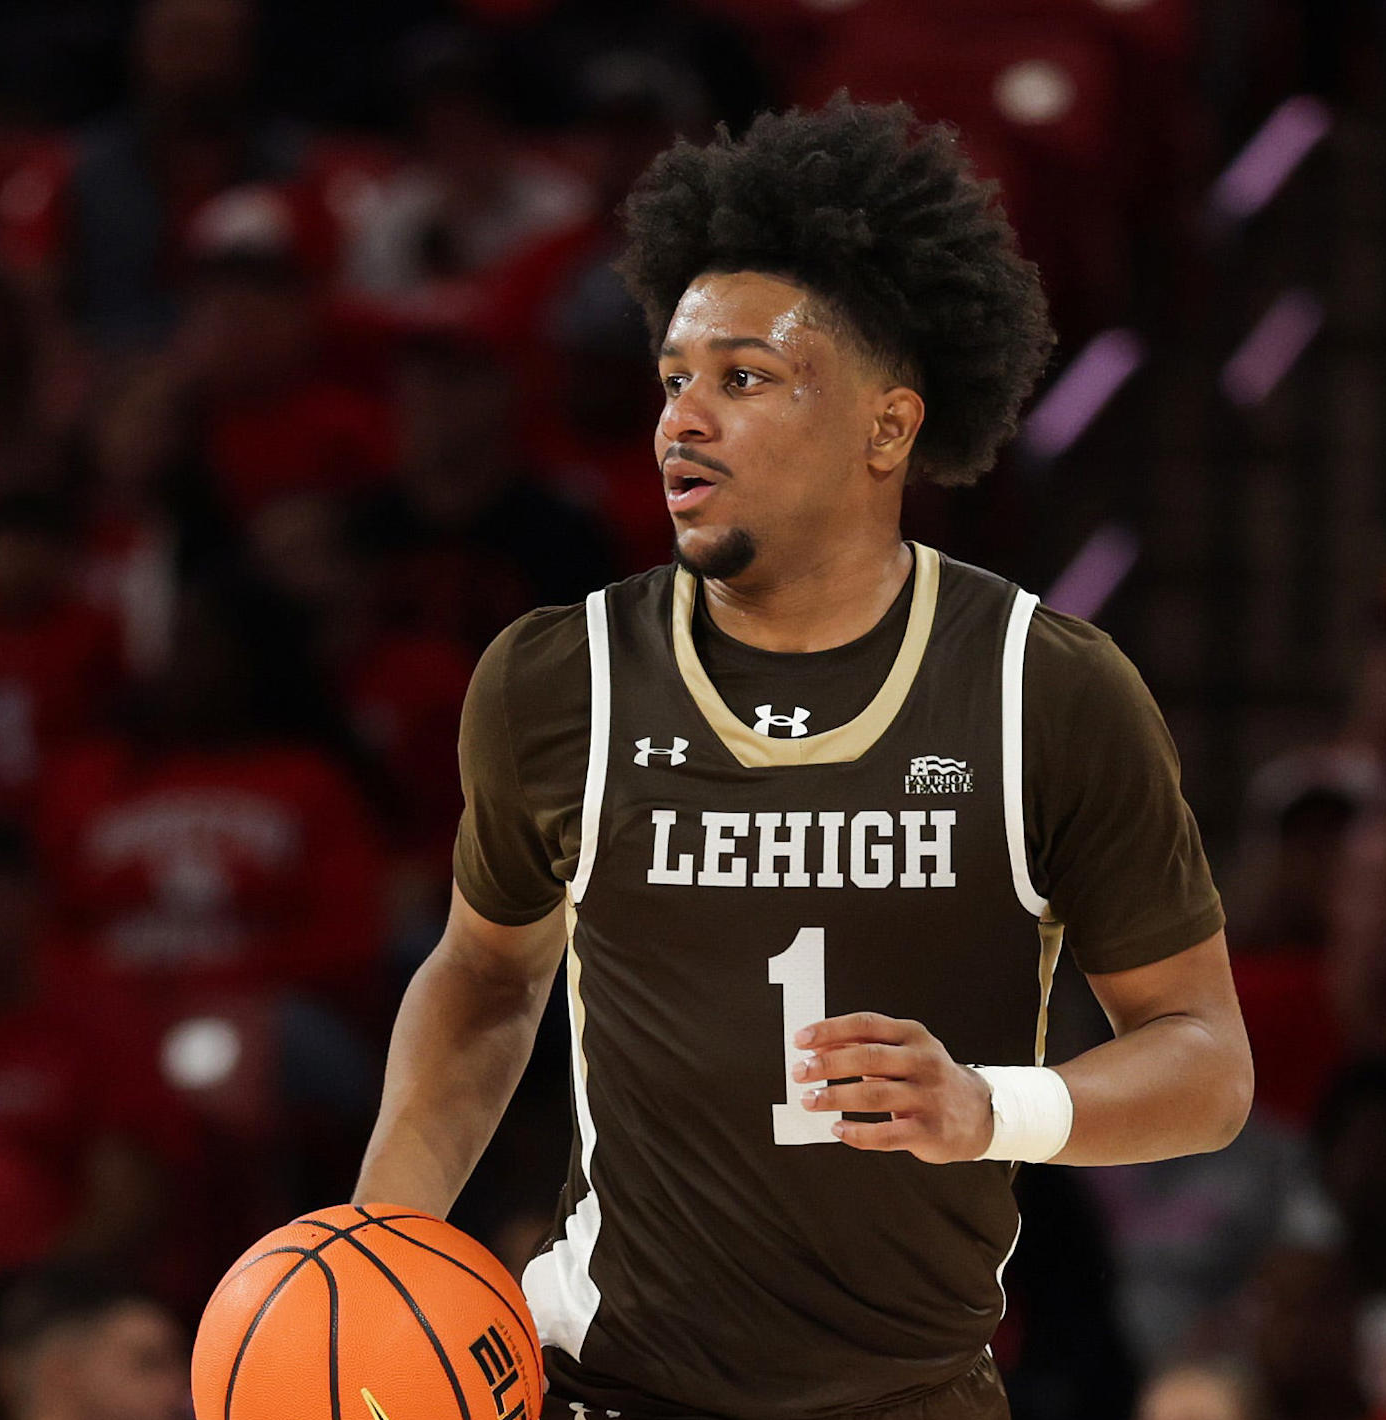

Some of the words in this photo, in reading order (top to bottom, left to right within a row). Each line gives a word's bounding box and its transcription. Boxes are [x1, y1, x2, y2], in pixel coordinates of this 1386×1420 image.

[904, 773, 973, 785] PATRIOT
[904, 783, 974, 794] LEAGUE
[647, 809, 957, 889] LEHIGH
[768, 926, 844, 1146] 1
